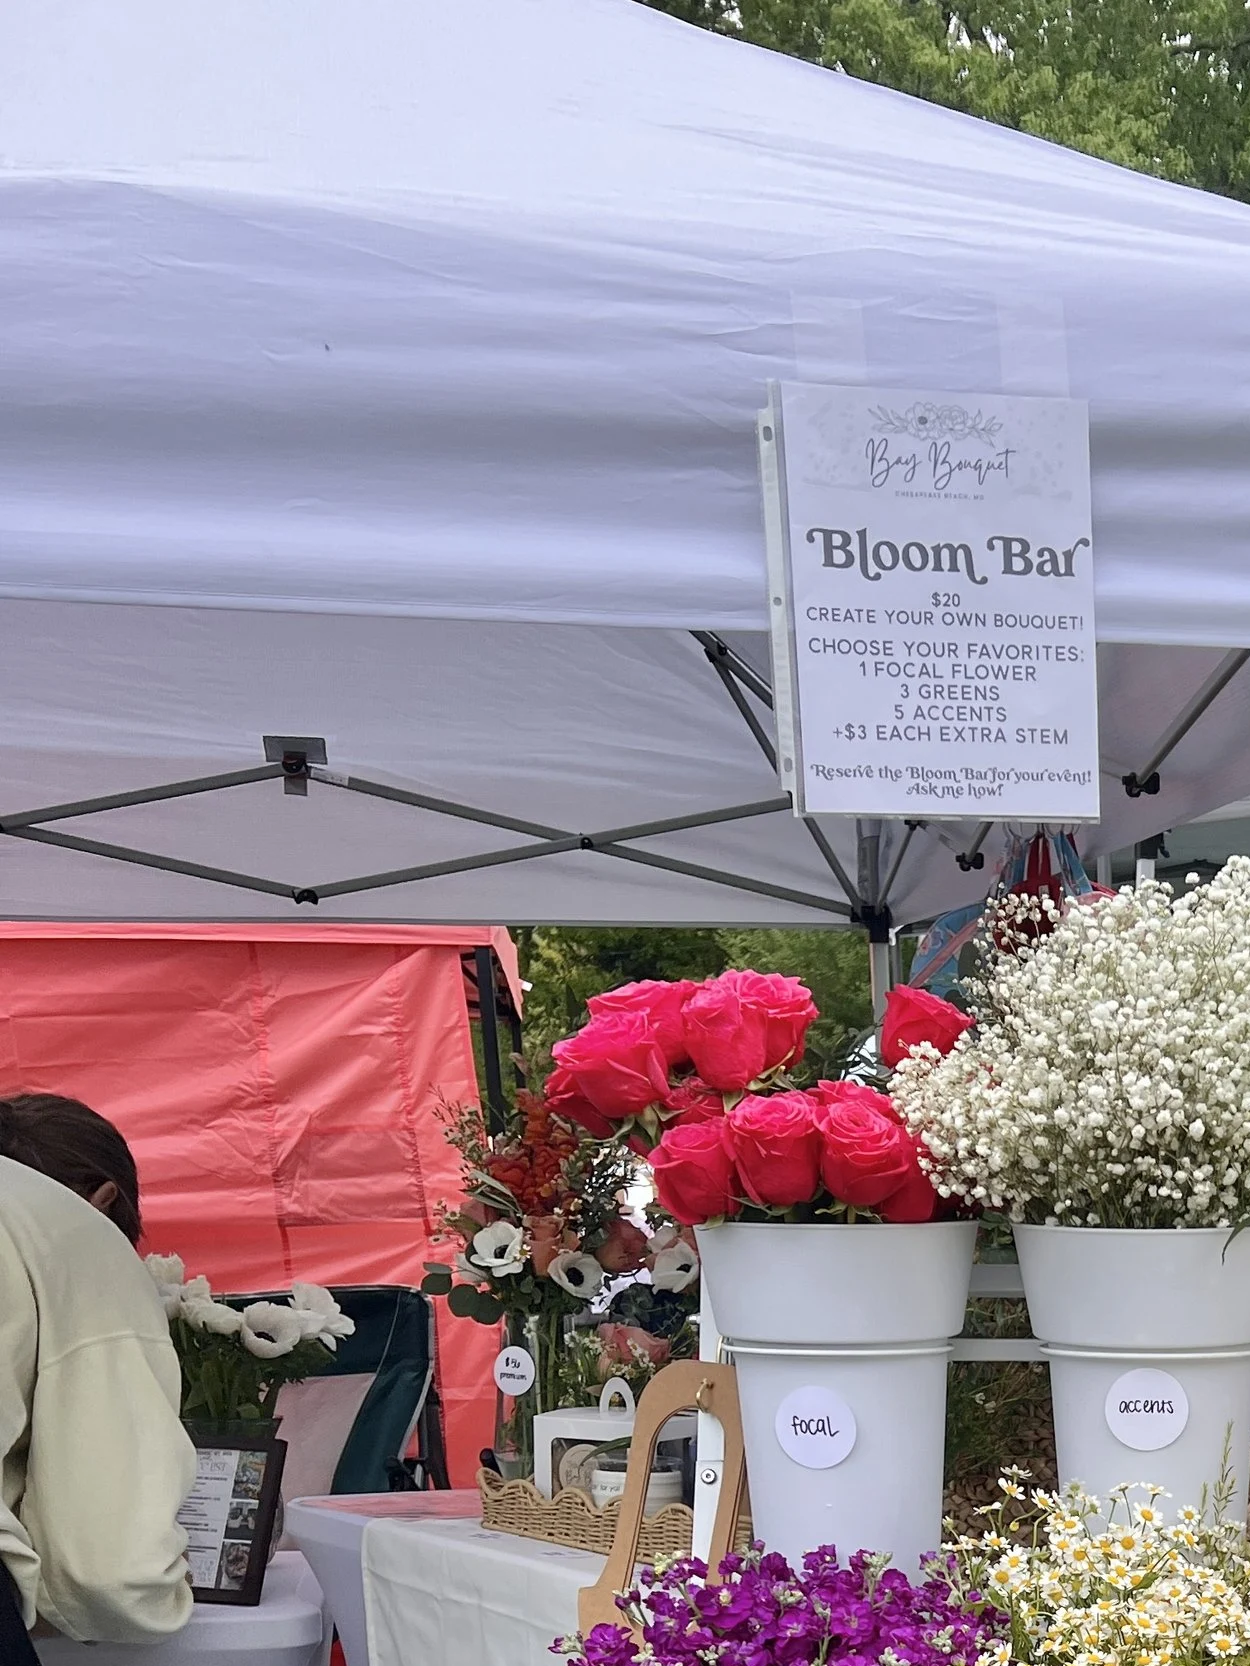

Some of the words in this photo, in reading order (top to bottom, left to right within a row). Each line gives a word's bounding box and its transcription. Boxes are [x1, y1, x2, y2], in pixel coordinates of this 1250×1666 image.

[865, 438, 923, 488] Bay
[928, 441, 1017, 491] Bouquet
[806, 527, 989, 586] Bloom
[986, 535, 1090, 578] Bar
[931, 591, 961, 608] $20
[806, 606, 877, 624] CREATE
[884, 609, 934, 627] YOUR
[941, 612, 987, 628] OWN
[993, 613, 1084, 631] BOUQUET!
[808, 637, 894, 657] CHOOSE
[903, 641, 959, 659] YOUR
[967, 643, 1085, 663] FAVORITES:
[858, 661, 867, 677] 1
[874, 661, 944, 679] FOCAL
[951, 663, 1037, 682] FLOWER
[900, 683, 910, 699] 3
[918, 684, 1000, 701] GREENS
[893, 704, 905, 720] 5
[913, 705, 1007, 723] ACCENTS
[832, 722, 868, 742] +$3
[876, 725, 931, 742] EACH
[939, 726, 1007, 744] EXTRA
[1015, 728, 1069, 745] STEM
[810, 764, 874, 781] Reserve
[878, 765, 903, 782] the
[906, 766, 960, 783] Bloom
[960, 767, 992, 781] Bar
[988, 768, 1015, 784] for
[1013, 768, 1049, 785] your
[1048, 769, 1093, 786] event!
[906, 782, 943, 798] Ask
[942, 784, 965, 799] me
[1118, 1399, 1174, 1415] accents
[791, 1415, 840, 1438] focal
